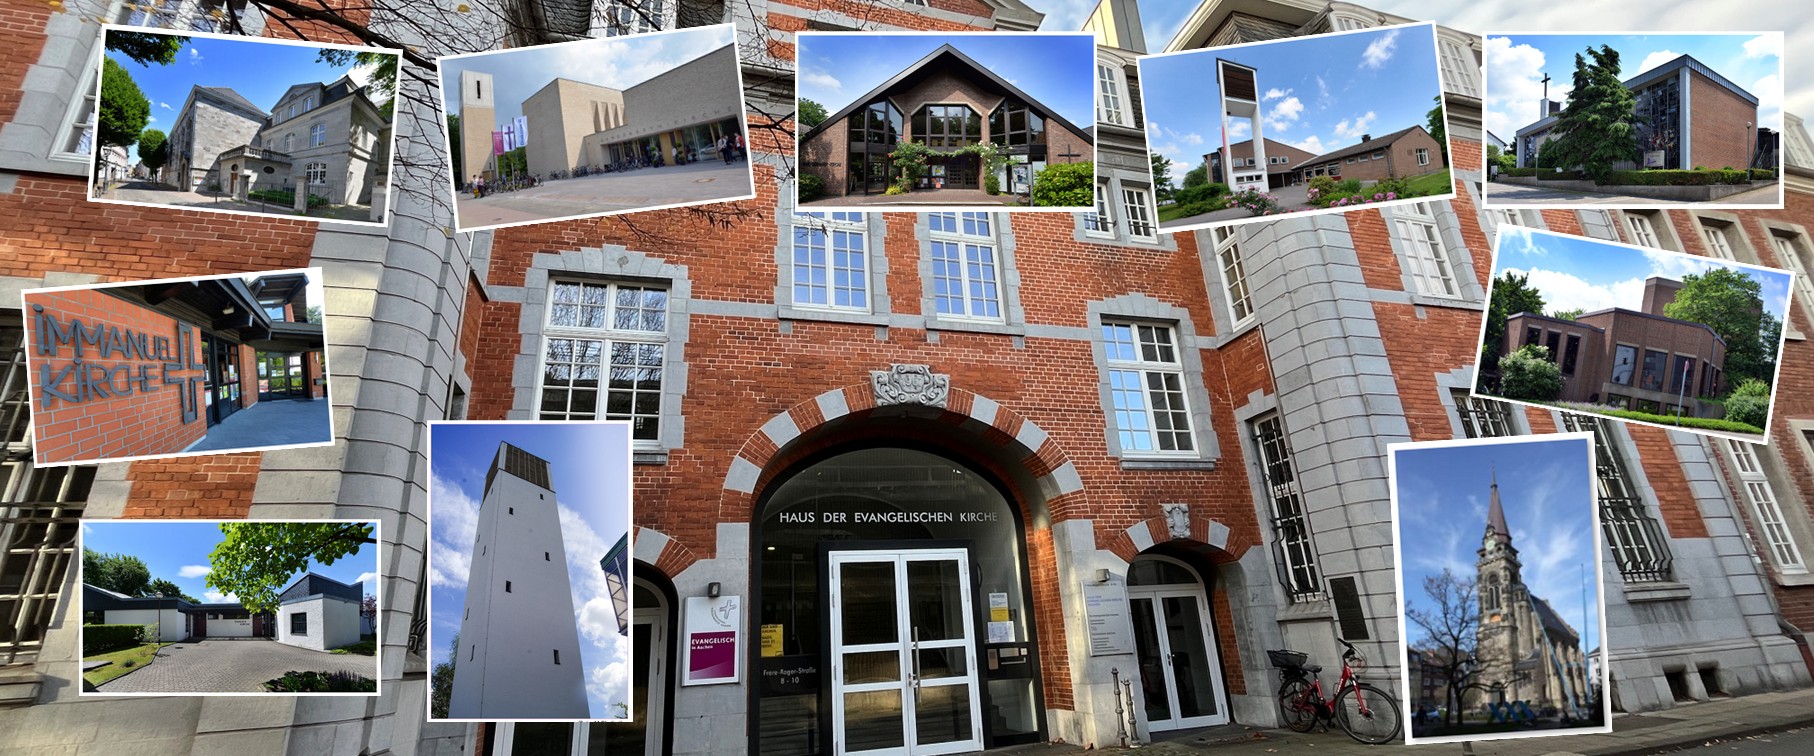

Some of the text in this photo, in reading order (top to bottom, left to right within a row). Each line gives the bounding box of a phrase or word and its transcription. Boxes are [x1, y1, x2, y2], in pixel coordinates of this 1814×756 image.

[779, 512, 998, 523] HAUS DER EVANGELISCHEN KIRCHE
[692, 637, 735, 645] EVANGELISCH
[791, 676, 800, 684] 10
